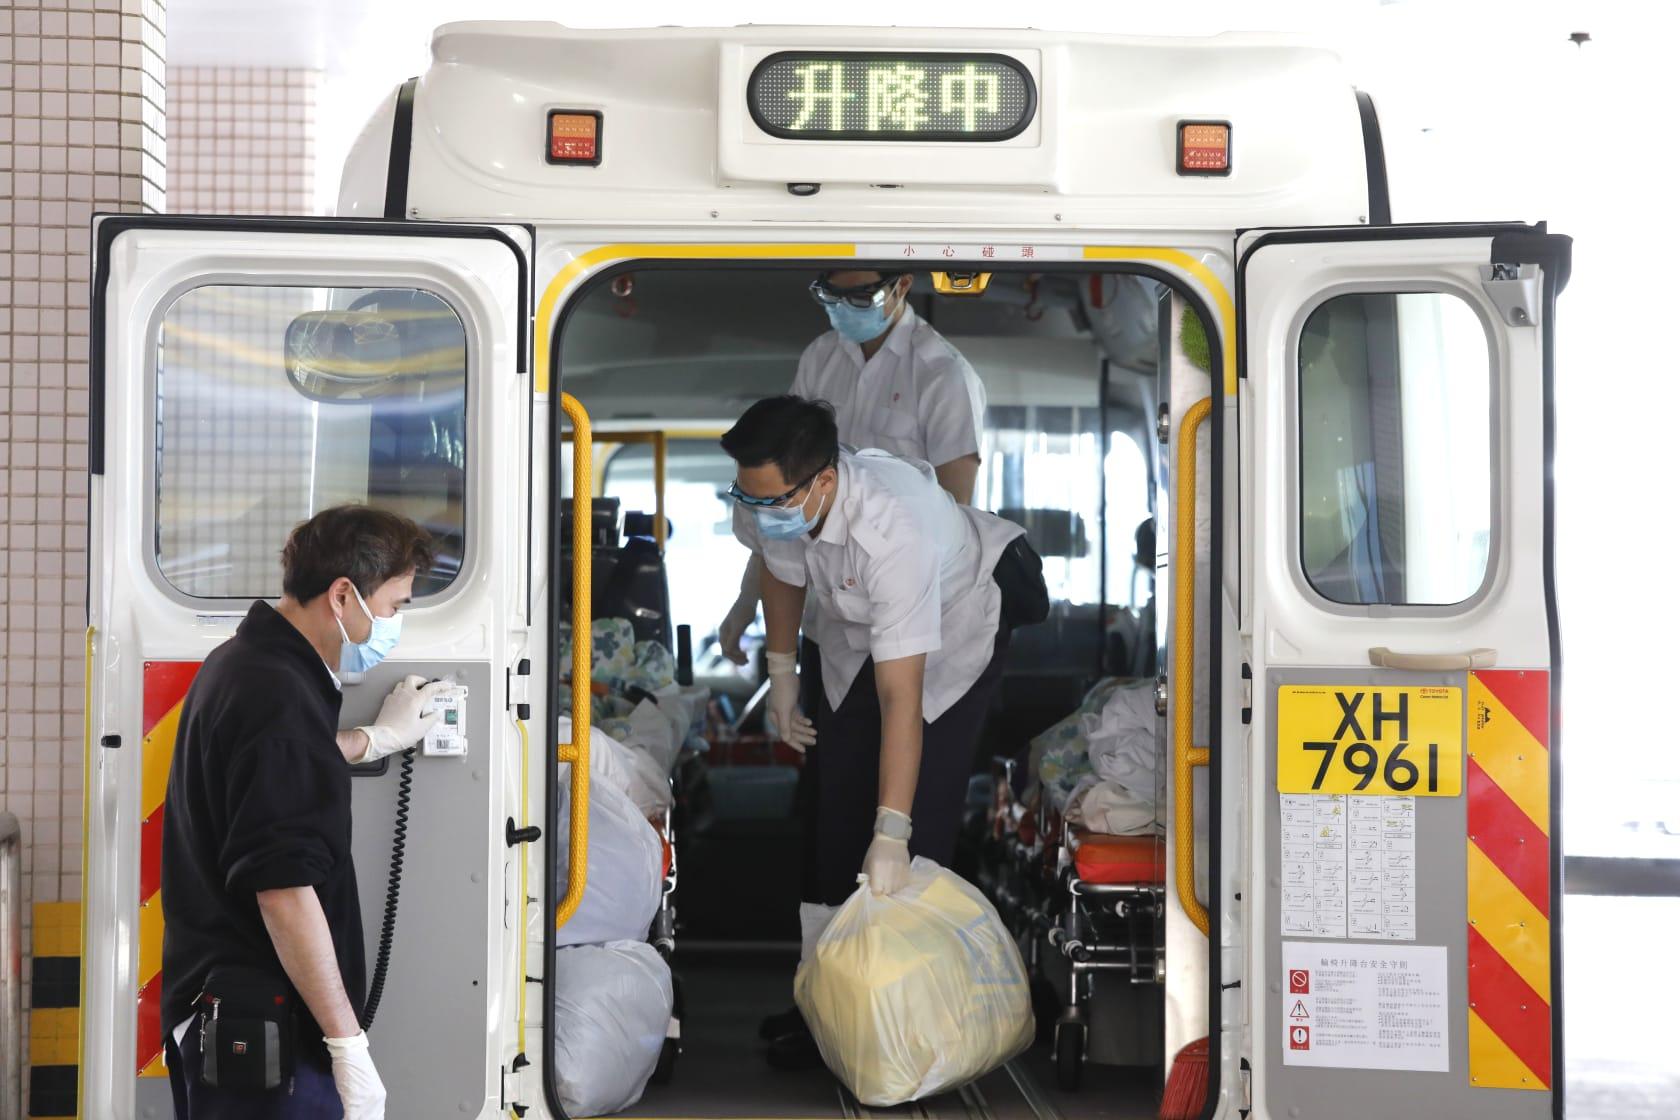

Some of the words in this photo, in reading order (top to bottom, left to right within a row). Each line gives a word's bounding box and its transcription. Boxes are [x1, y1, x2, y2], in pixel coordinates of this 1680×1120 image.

[788, 64, 998, 131] 升降中
[904, 244, 1034, 258] 小心碰頭
[1334, 692, 1408, 741] XH
[1303, 742, 1438, 792] 7961
